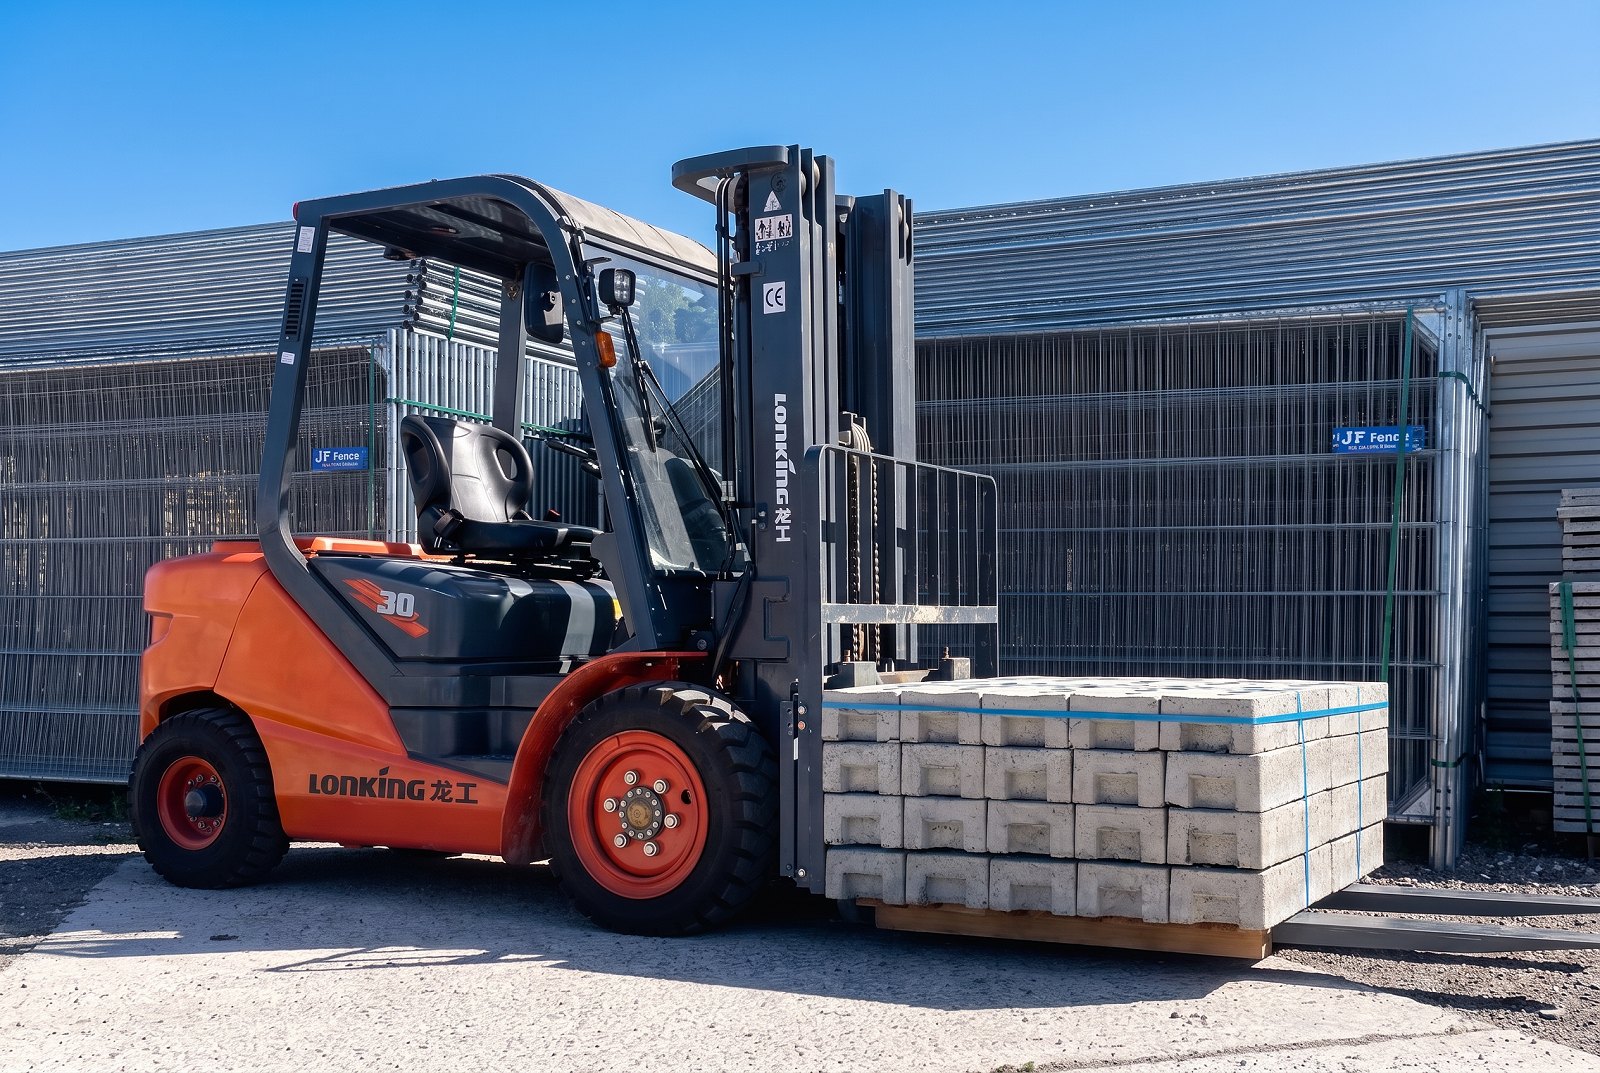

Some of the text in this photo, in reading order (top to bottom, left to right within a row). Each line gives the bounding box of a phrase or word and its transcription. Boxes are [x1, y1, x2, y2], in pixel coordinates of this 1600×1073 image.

[766, 287, 784, 308] CE
[1341, 431, 1366, 445] JF
[315, 450, 360, 463] JF Fence
[774, 507, 792, 542] 龙工
[376, 590, 415, 618] 30
[430, 779, 479, 804] 龙工
